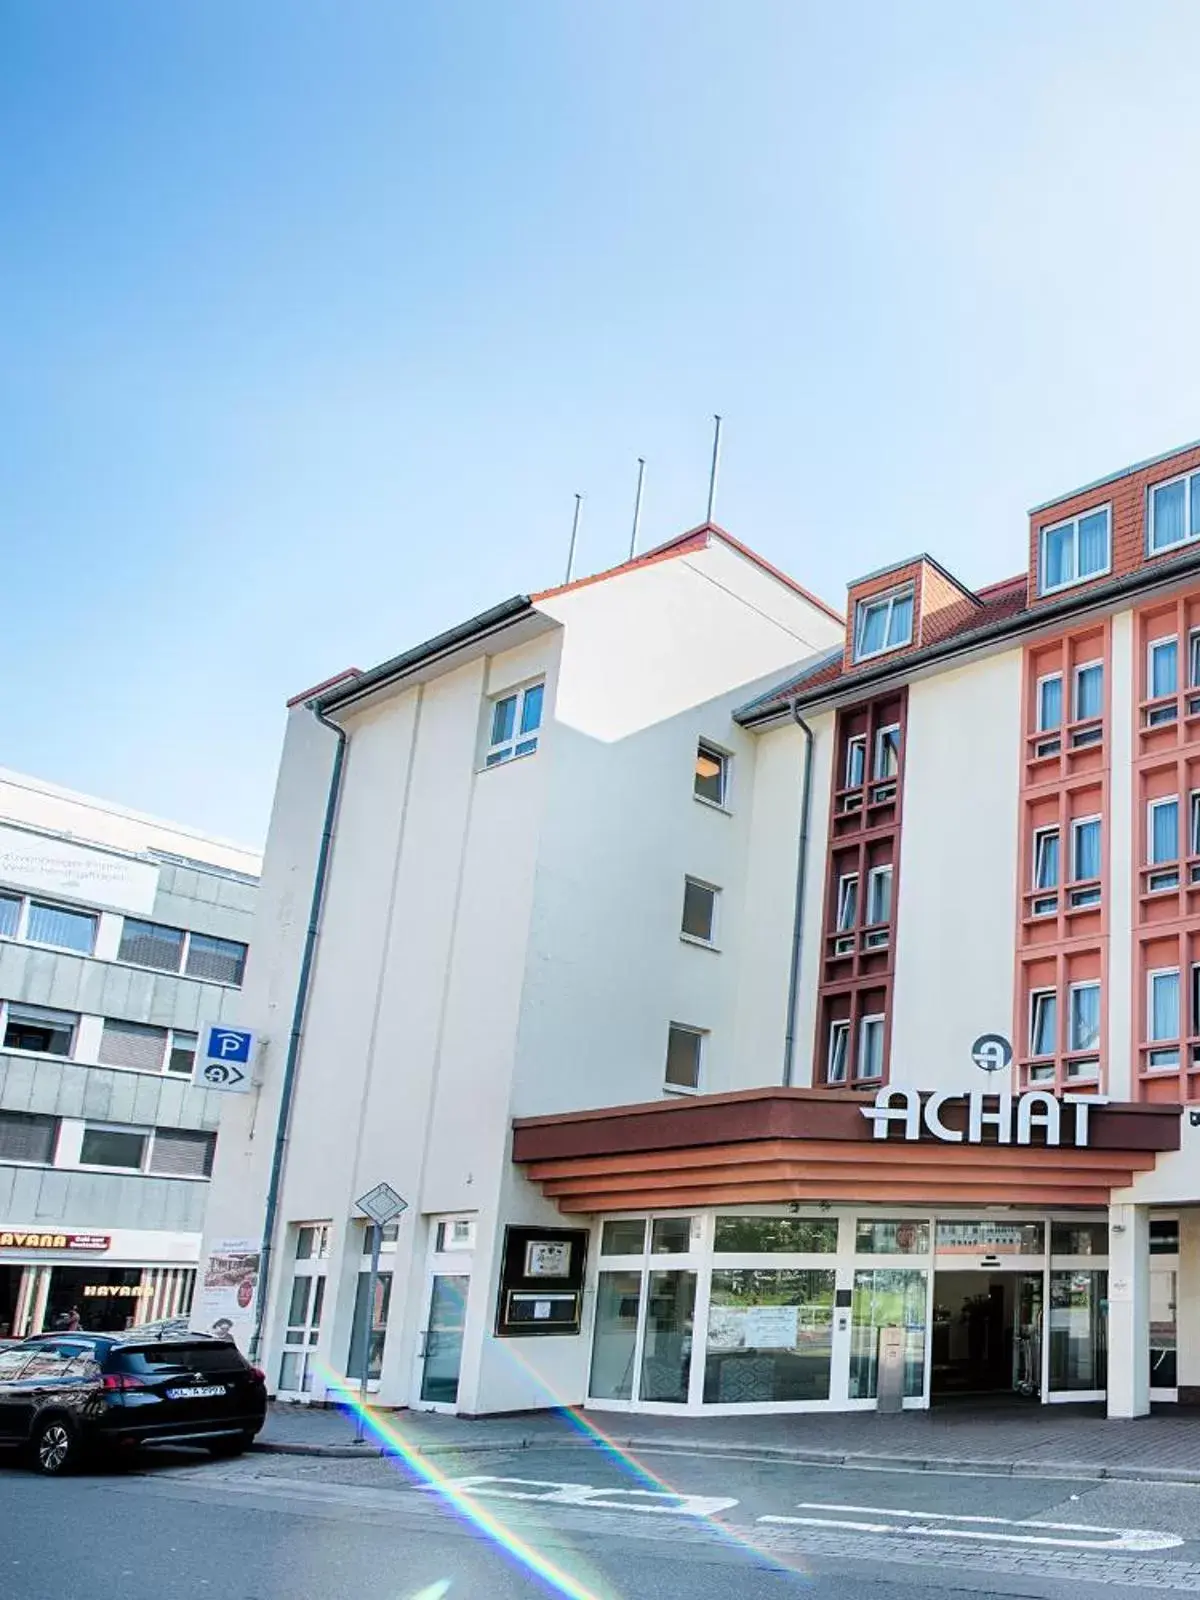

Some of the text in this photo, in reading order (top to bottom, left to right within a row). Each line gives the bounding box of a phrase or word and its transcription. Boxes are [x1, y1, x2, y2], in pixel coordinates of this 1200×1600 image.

[220, 1038, 240, 1057] P
[861, 1084, 1109, 1148] ACHAT
[84, 1285, 154, 1297] HAVANA
